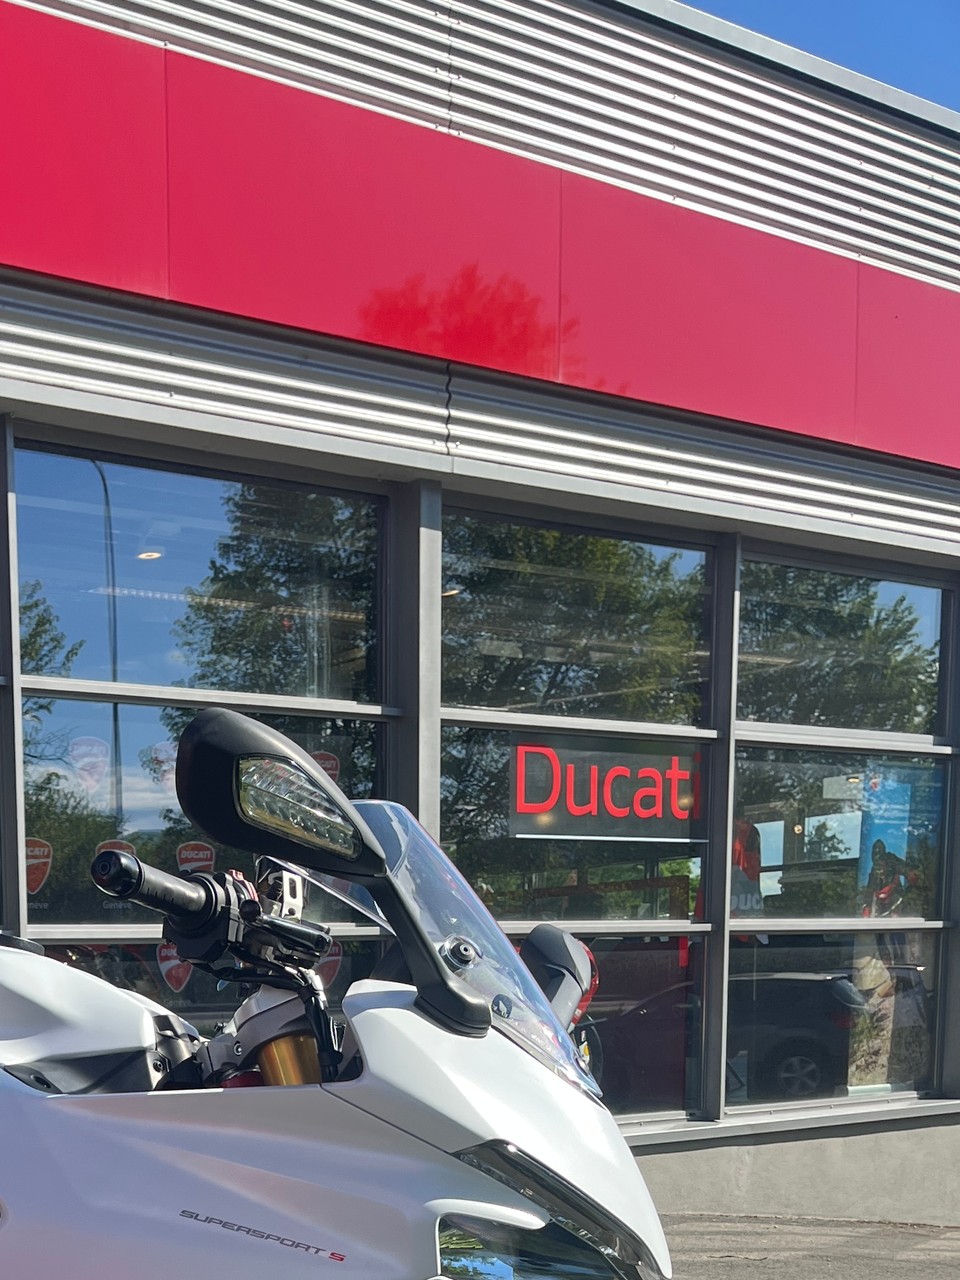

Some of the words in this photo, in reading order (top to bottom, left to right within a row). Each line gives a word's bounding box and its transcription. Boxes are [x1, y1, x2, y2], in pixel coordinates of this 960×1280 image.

[515, 744, 701, 820] Ducati
[26, 847, 49, 856] CATI
[181, 850, 211, 859] DUCATI
[178, 1209, 327, 1256] SUPERSPORT
[328, 1251, 347, 1263] S
